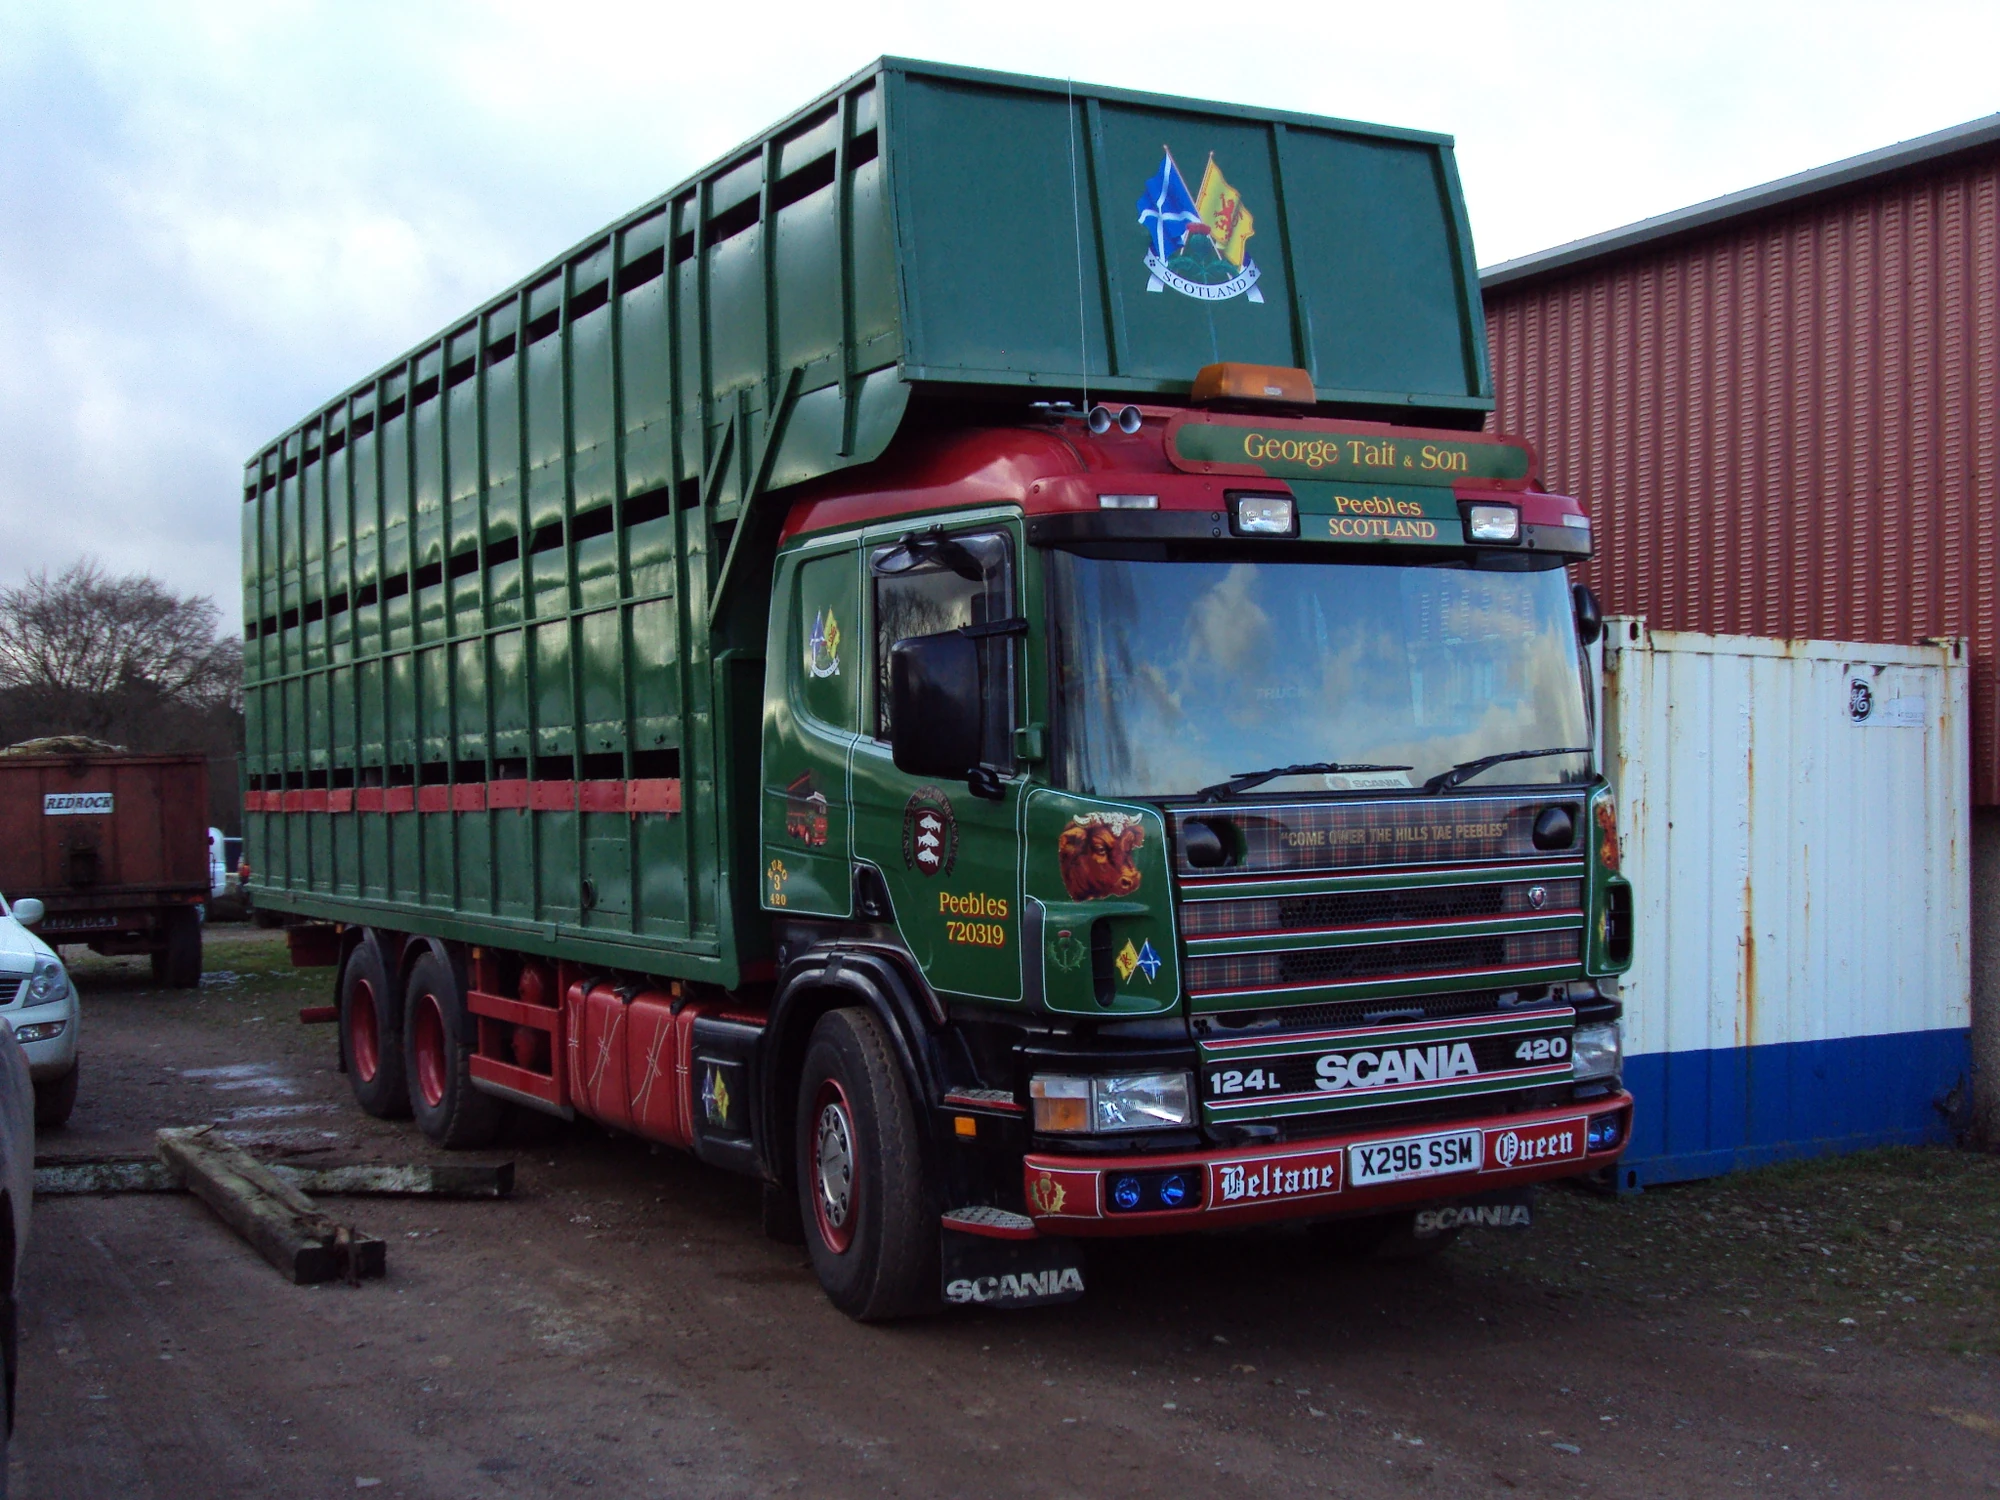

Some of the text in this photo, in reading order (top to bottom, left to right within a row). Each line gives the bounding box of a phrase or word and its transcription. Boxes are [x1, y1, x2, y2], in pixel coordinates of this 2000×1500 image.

[1162, 271, 1247, 298] SCOTLAND
[1243, 433, 1468, 472] George Tait & Son
[1333, 496, 1423, 516] Peebles
[1328, 518, 1437, 539] SCOTLAND
[1352, 778, 1405, 788] SCANIA
[45, 796, 113, 809] REDROCK
[1328, 828, 1366, 844] OWER
[1369, 827, 1393, 843] THE
[1396, 825, 1429, 842] HILLS
[1431, 825, 1452, 842] TAE
[770, 893, 787, 906] 420
[939, 891, 1008, 918] Peebles
[945, 921, 1005, 946] 720319
[1515, 1037, 1567, 1061] 420
[1315, 1043, 1479, 1091] SCANIA
[1360, 1136, 1473, 1177] X296 SSM
[1495, 1131, 1574, 1167] Queen
[1220, 1163, 1334, 1200] Beltane
[1413, 1205, 1531, 1233] SCANIA
[946, 1267, 1086, 1303] SCANIA
